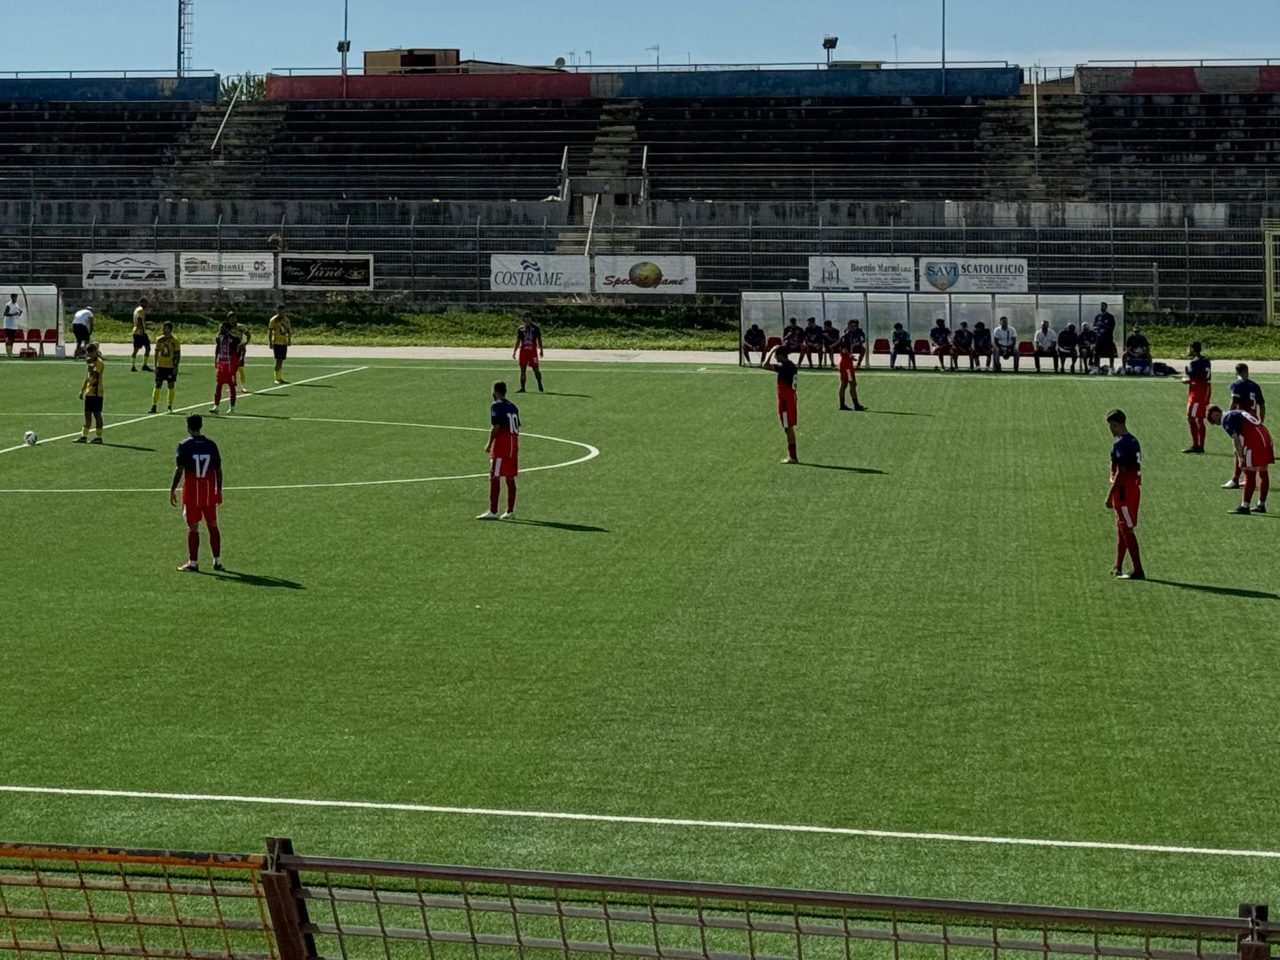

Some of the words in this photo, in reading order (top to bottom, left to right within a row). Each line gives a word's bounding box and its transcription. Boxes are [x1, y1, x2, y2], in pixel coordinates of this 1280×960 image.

[86, 270, 167, 280] PICA
[927, 266, 958, 277] SAVI
[960, 264, 1024, 275] SCATOLIFICIO
[494, 271, 564, 287] COSTRAME
[506, 413, 519, 434] 10
[192, 454, 211, 478] 17
